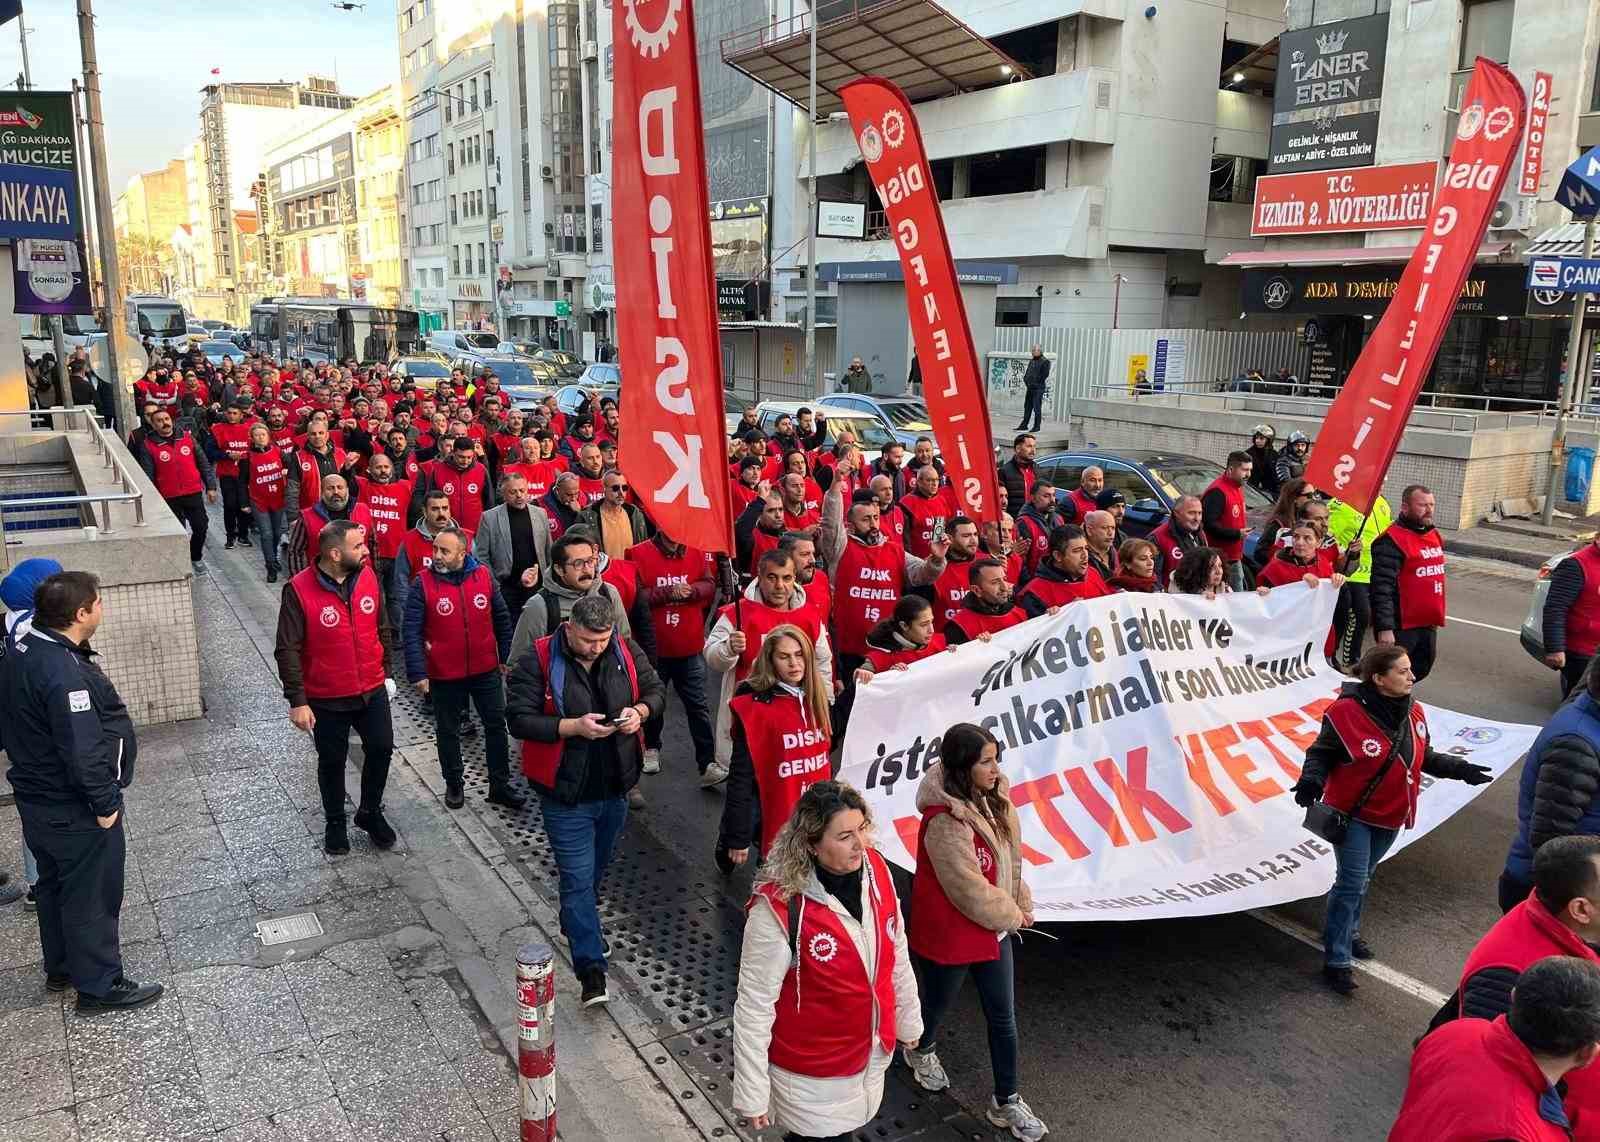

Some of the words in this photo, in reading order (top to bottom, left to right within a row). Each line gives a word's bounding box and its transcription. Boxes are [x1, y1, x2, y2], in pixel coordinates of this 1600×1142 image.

[1291, 50, 1371, 83] TANER
[1296, 76, 1361, 106] EREN
[1535, 78, 1549, 111] 2.
[20, 135, 71, 144] DAKİKADA
[1288, 134, 1320, 148] GELİNLİK
[1324, 130, 1359, 145] NİŞANLIK
[1273, 153, 1301, 165] KAFTAN
[1304, 149, 1327, 161] ABİYE
[1330, 147, 1349, 159] ÖZEL
[1350, 142, 1372, 156] DİKİM
[1523, 115, 1546, 190] NOTER
[1327, 175, 1356, 193] T.C.
[0, 181, 70, 225] NKAYA
[1258, 194, 1305, 228] İZMİR
[1309, 202, 1322, 226] 2.
[1326, 182, 1430, 224] NOTERLİĞİ
[1566, 184, 1595, 208] M
[34, 276, 67, 284] SONRASI
[457, 283, 482, 297] ALVINA
[720, 287, 744, 295] ALTIN
[1304, 283, 1338, 298] ADA
[719, 296, 746, 305] DUVAK
[257, 463, 280, 473] DİSK
[371, 495, 398, 506] DİSK
[377, 523, 388, 533] İŞ
[656, 574, 689, 588] DİSK
[860, 566, 891, 582] DİSK
[850, 586, 897, 601] GENEL
[666, 612, 680, 627] İŞ
[864, 604, 880, 622] İŞ
[1111, 606, 1193, 656] iadeler
[1198, 616, 1233, 648] ve
[865, 733, 942, 796] işte
[1176, 664, 1222, 702] son
[1215, 641, 1316, 697] bulsun!
[778, 751, 829, 778] GENEL
[1180, 865, 1254, 900] İZMİR
[1252, 852, 1301, 884] 1,2,3
[1292, 838, 1330, 862] VE
